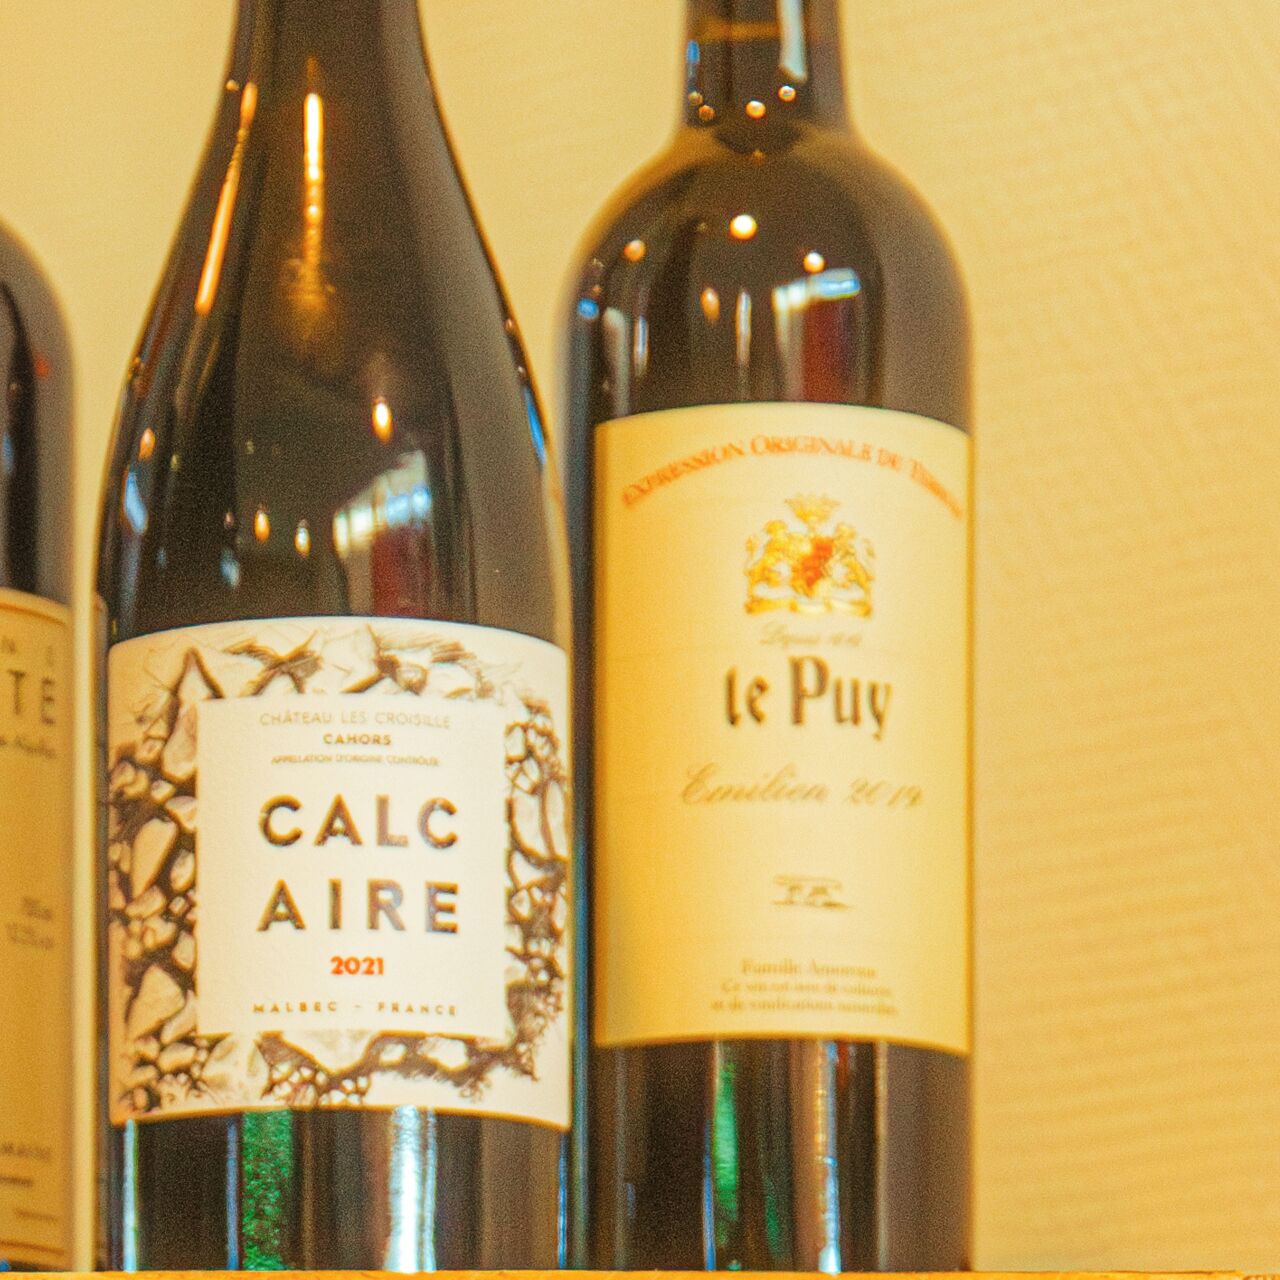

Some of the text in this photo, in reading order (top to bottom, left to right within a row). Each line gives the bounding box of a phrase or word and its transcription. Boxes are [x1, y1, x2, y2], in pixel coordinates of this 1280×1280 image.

[724, 656, 892, 741] le Puy
[340, 711, 368, 725] LES
[322, 733, 393, 746] CAHORS
[258, 794, 459, 850] CALC
[256, 879, 459, 934] AIRE
[330, 955, 385, 977] 2021
[253, 1000, 338, 1014] MALBEC
[378, 1001, 456, 1016] FRANCE
